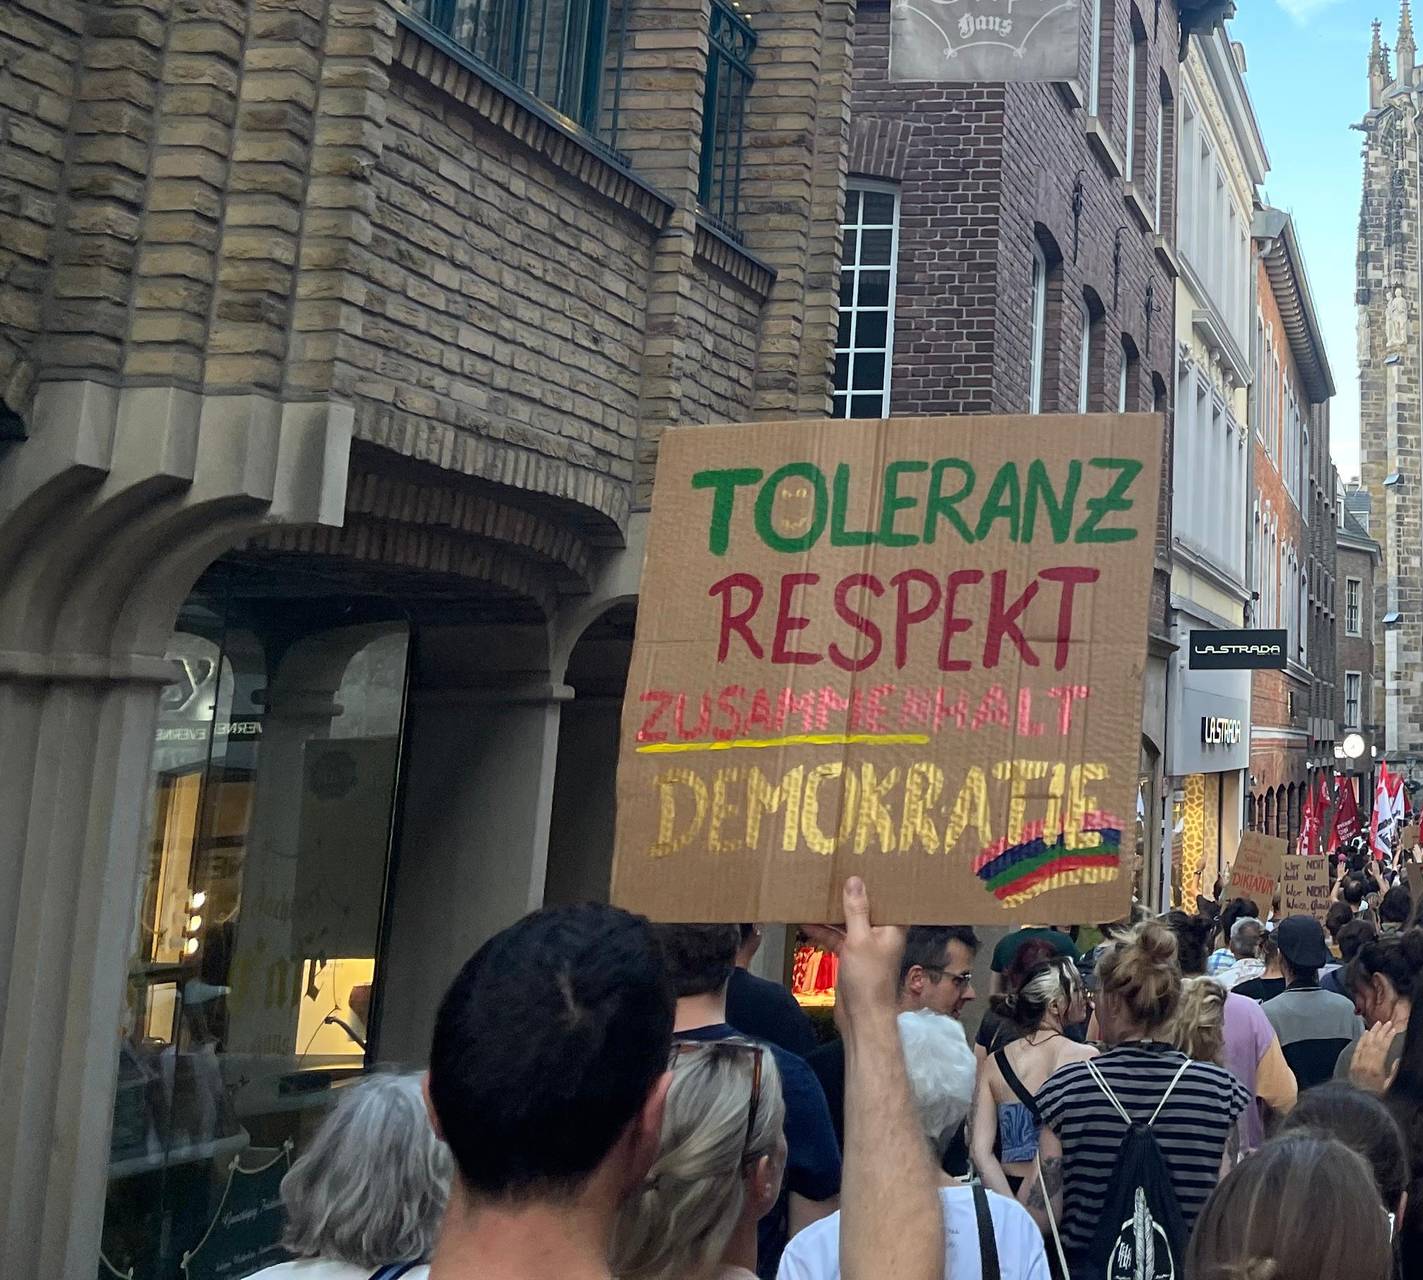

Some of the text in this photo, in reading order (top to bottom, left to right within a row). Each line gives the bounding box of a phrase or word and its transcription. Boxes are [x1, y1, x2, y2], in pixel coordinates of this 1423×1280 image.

[691, 457, 1144, 556] TOLERANZ
[708, 567, 1100, 672] RESPEKT
[636, 684, 1090, 742] ZUSAMMENHALT
[647, 759, 1110, 857] DEMOKRATIE
